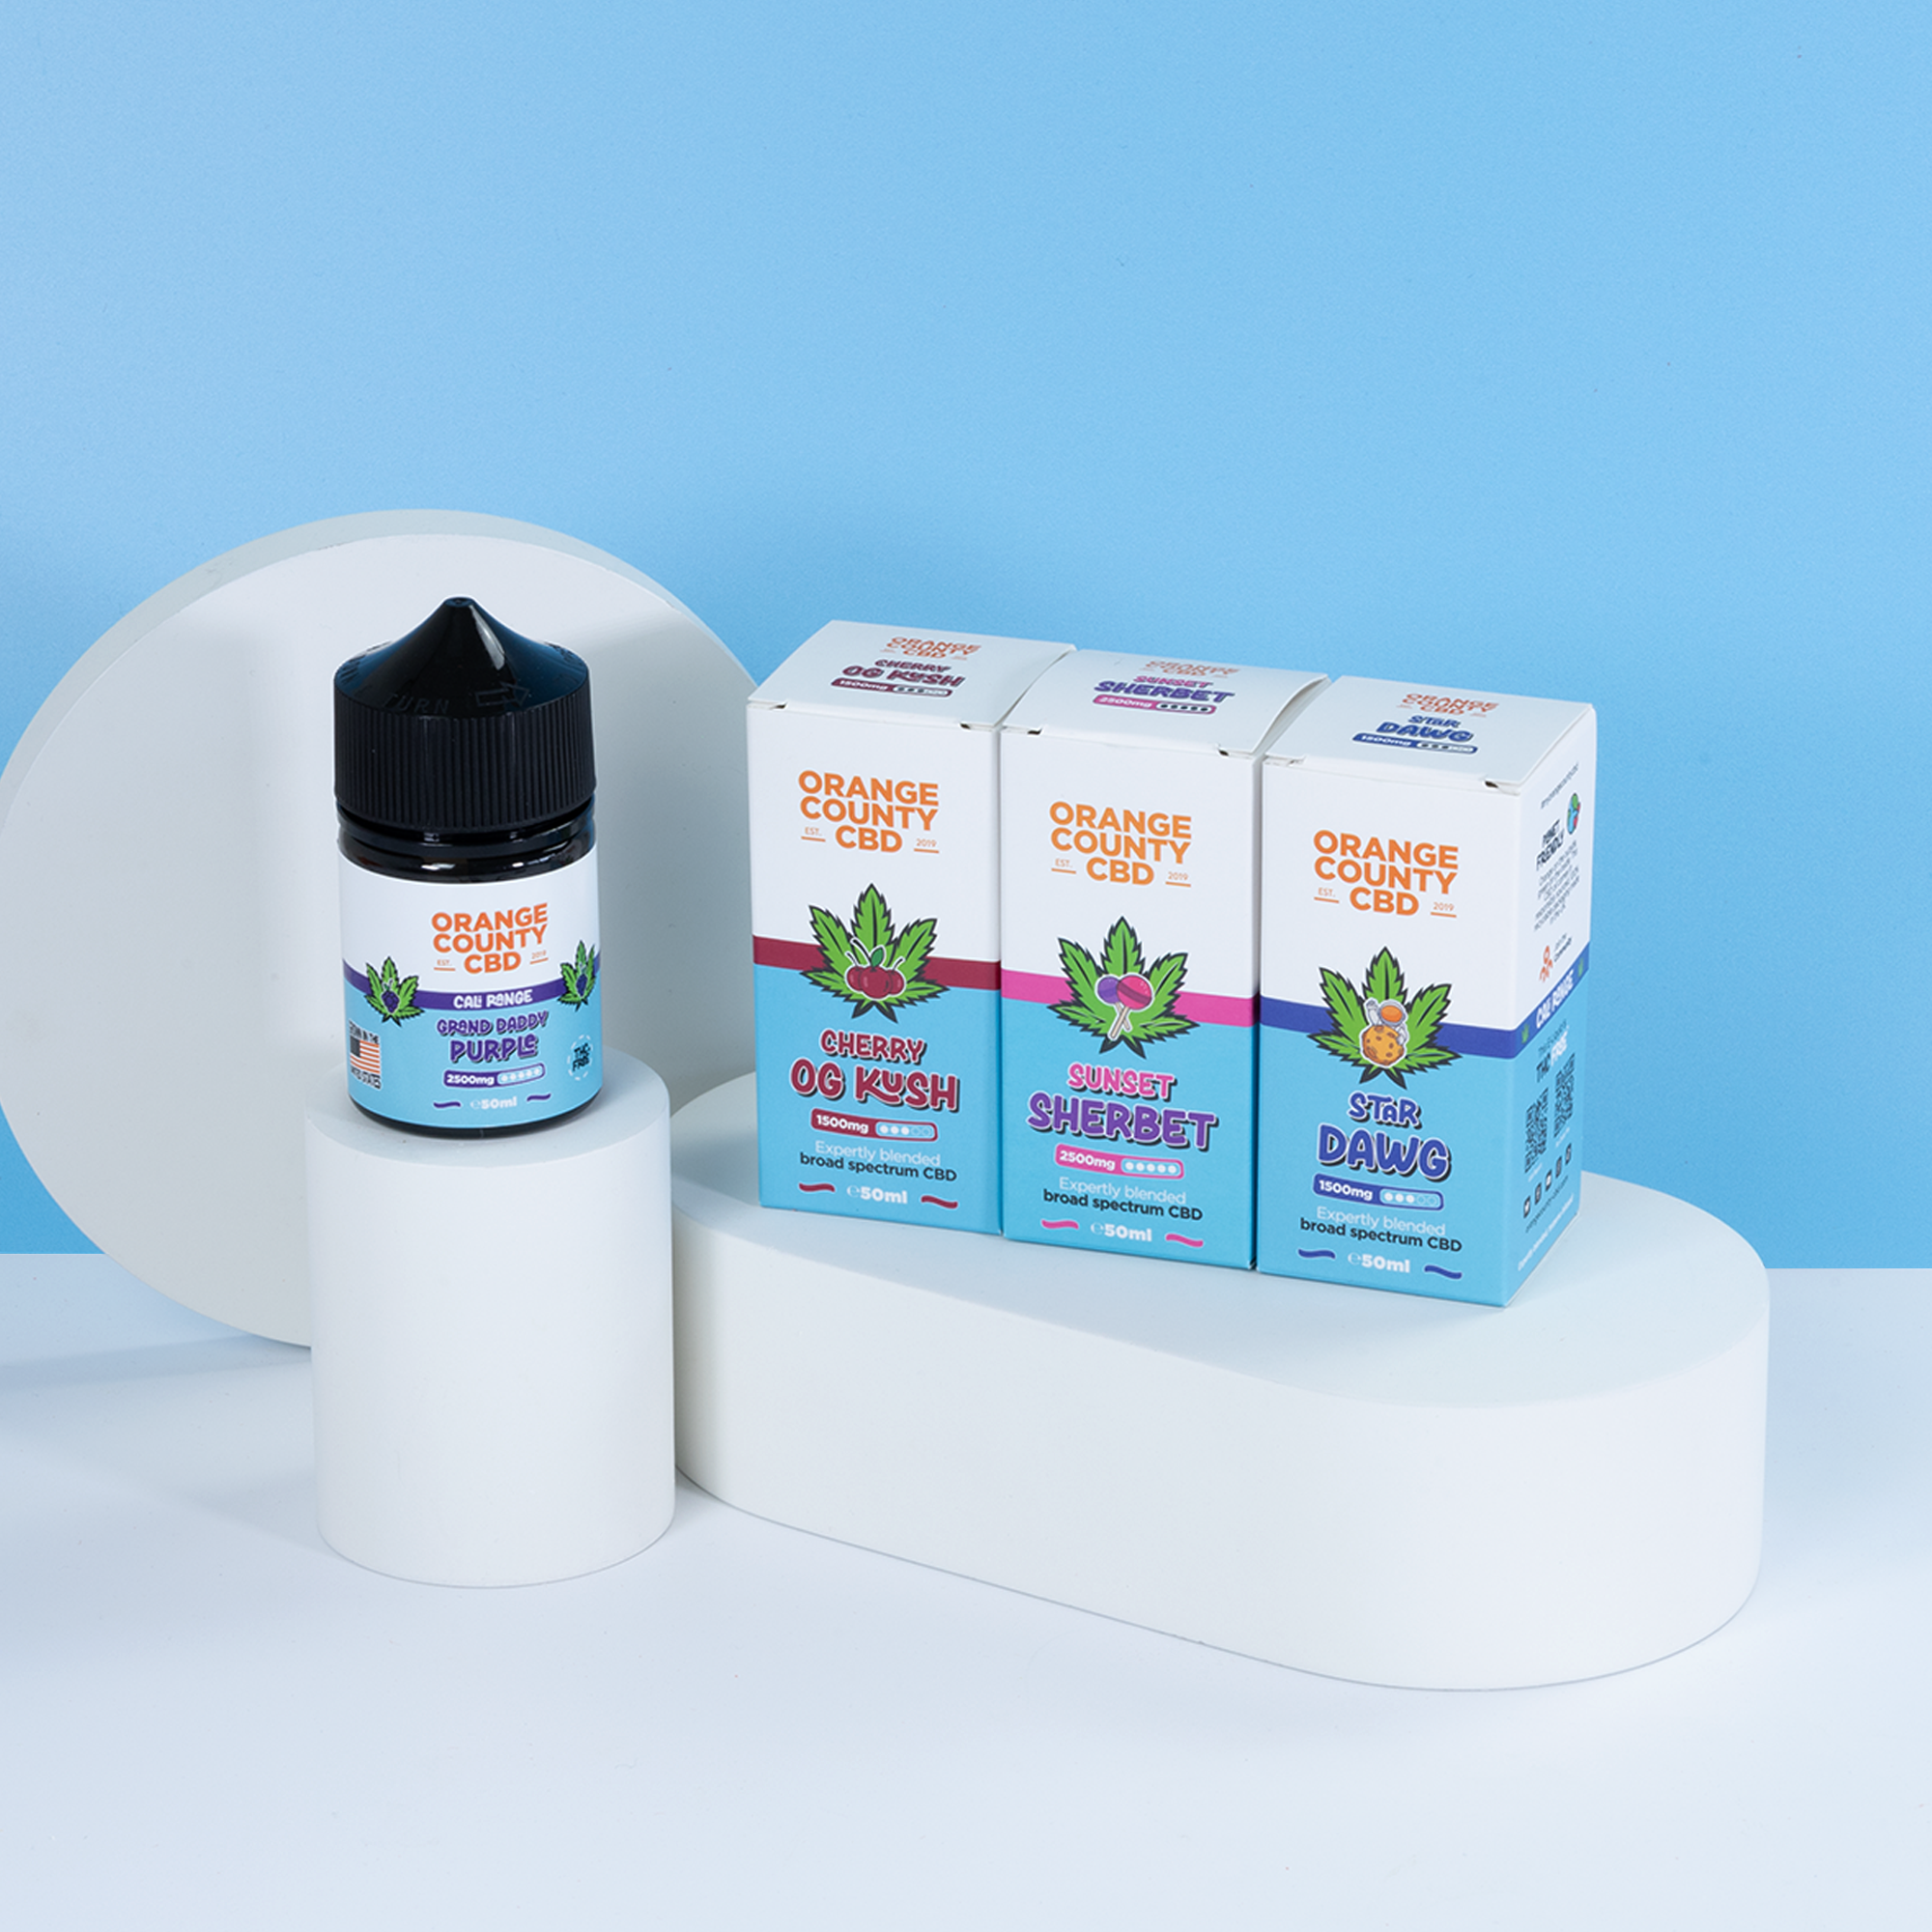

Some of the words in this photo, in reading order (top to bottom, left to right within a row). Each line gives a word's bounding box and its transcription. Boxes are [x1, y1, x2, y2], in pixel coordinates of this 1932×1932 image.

[842, 665, 885, 679] OG
[887, 669, 966, 688] KUSH
[874, 659, 952, 673] CHERRY
[1094, 680, 1236, 703] SHERBET
[1133, 675, 1214, 689] SUNSET
[1376, 722, 1474, 743] DAWG
[798, 770, 939, 807] ORANGE
[800, 796, 939, 832] COUNTY
[1049, 801, 1192, 839] ORANGE
[836, 825, 903, 853] CBD
[1051, 827, 1192, 865] COUNTY
[1313, 830, 1459, 869] ORANGE
[1086, 857, 1154, 886] CBD
[1315, 856, 1459, 895] COUNTY
[1318, 887, 1336, 897] EST.
[1350, 886, 1420, 916] CBD
[1433, 901, 1455, 912] 2019
[431, 902, 548, 932] ORANGE
[433, 923, 548, 953] COUNTY
[464, 952, 522, 975] CBD
[496, 1009, 550, 1035] DADDY
[820, 1028, 927, 1065] CHERRY
[446, 1073, 496, 1086] 2500mg
[790, 1058, 846, 1101] OG
[855, 1065, 960, 1113] KUSH
[1067, 1063, 1178, 1102] SUNSET
[816, 1114, 869, 1134] 1500mg
[1026, 1091, 1219, 1151] SHERBET
[800, 1151, 844, 1170] broad
[848, 1158, 919, 1179] spectrum
[923, 1166, 957, 1181] CBD
[815, 1140, 876, 1161] Expertly
[880, 1148, 941, 1167] blended
[1059, 1150, 1116, 1172] 2500mg
[1318, 1122, 1452, 1182] DAWG
[1043, 1189, 1089, 1208] broad
[1093, 1196, 1164, 1217] spectrum
[1168, 1205, 1204, 1221] CBD
[1059, 1177, 1122, 1200] Expertly
[1124, 1184, 1187, 1205] blended
[1319, 1179, 1373, 1201] 1500mg
[1300, 1217, 1346, 1236] broad
[1350, 1227, 1423, 1247] spectrum
[1427, 1236, 1463, 1253] CBD
[1317, 1206, 1379, 1229] Expertly
[1383, 1215, 1446, 1236] blended
